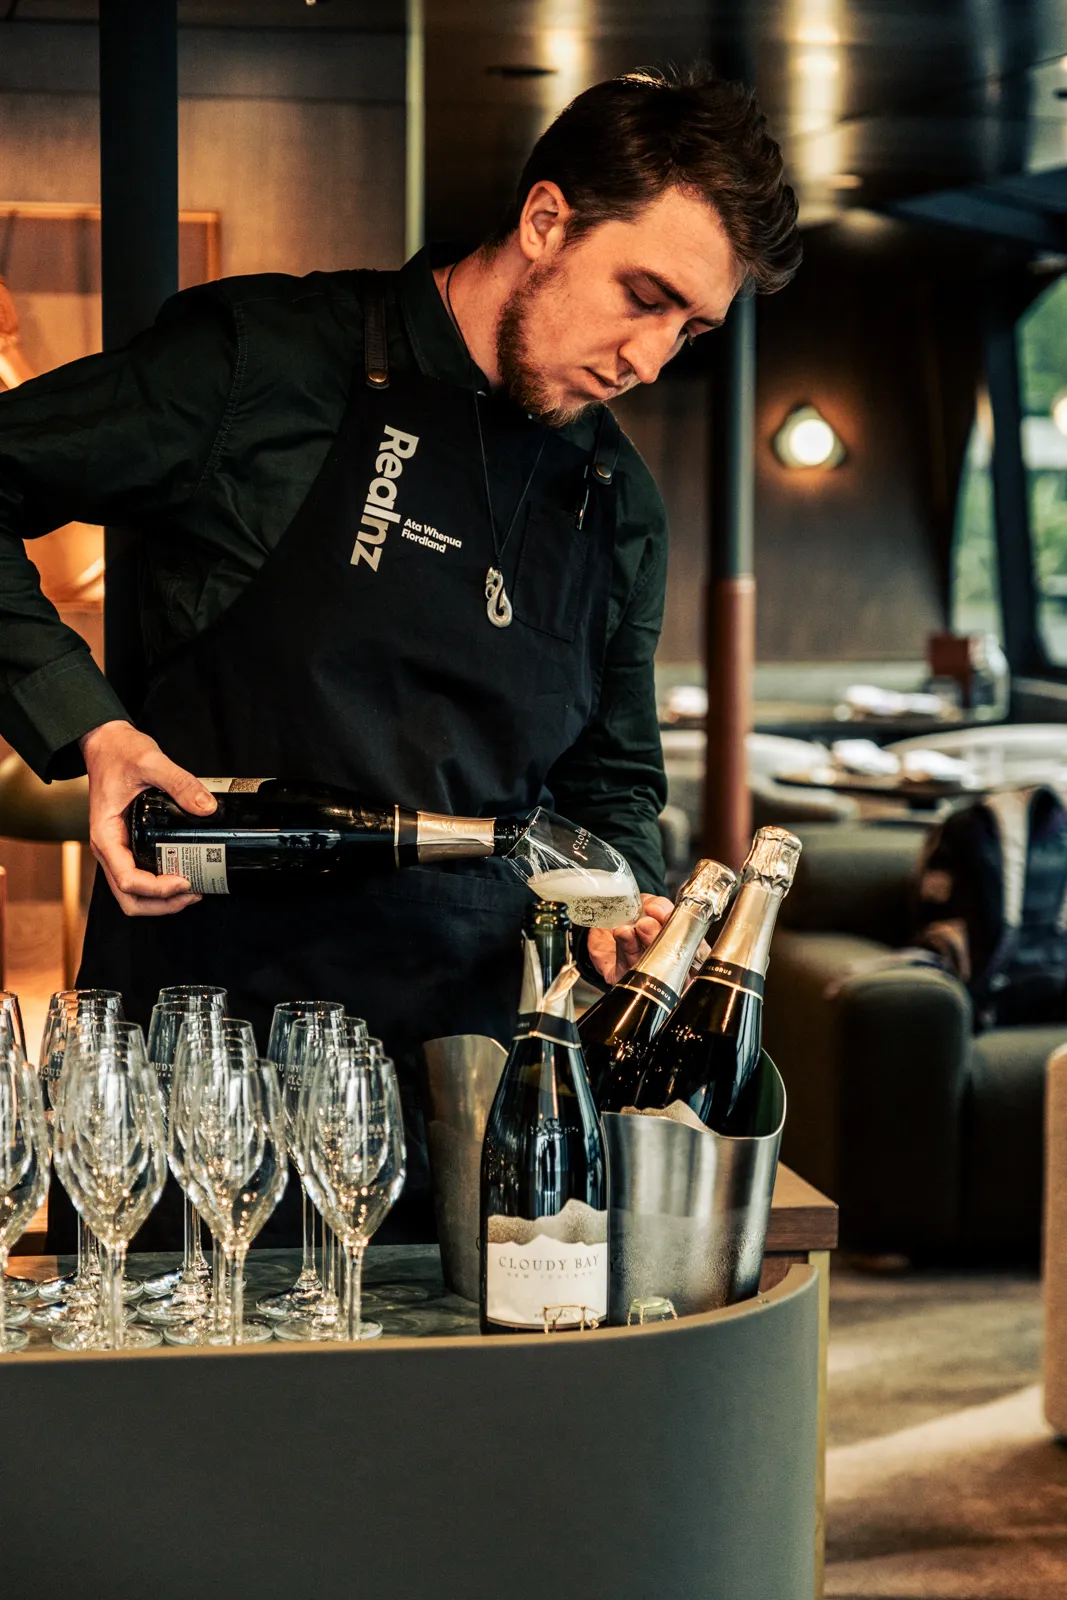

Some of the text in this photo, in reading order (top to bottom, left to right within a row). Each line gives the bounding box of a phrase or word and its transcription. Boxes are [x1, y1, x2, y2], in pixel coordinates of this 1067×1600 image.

[350, 424, 420, 572] Realnz
[401, 528, 447, 553] Fiordland
[403, 518, 462, 548] Ata Whenua
[705, 965, 732, 976] ELORUS
[498, 1254, 599, 1271] CLOUDY BAY
